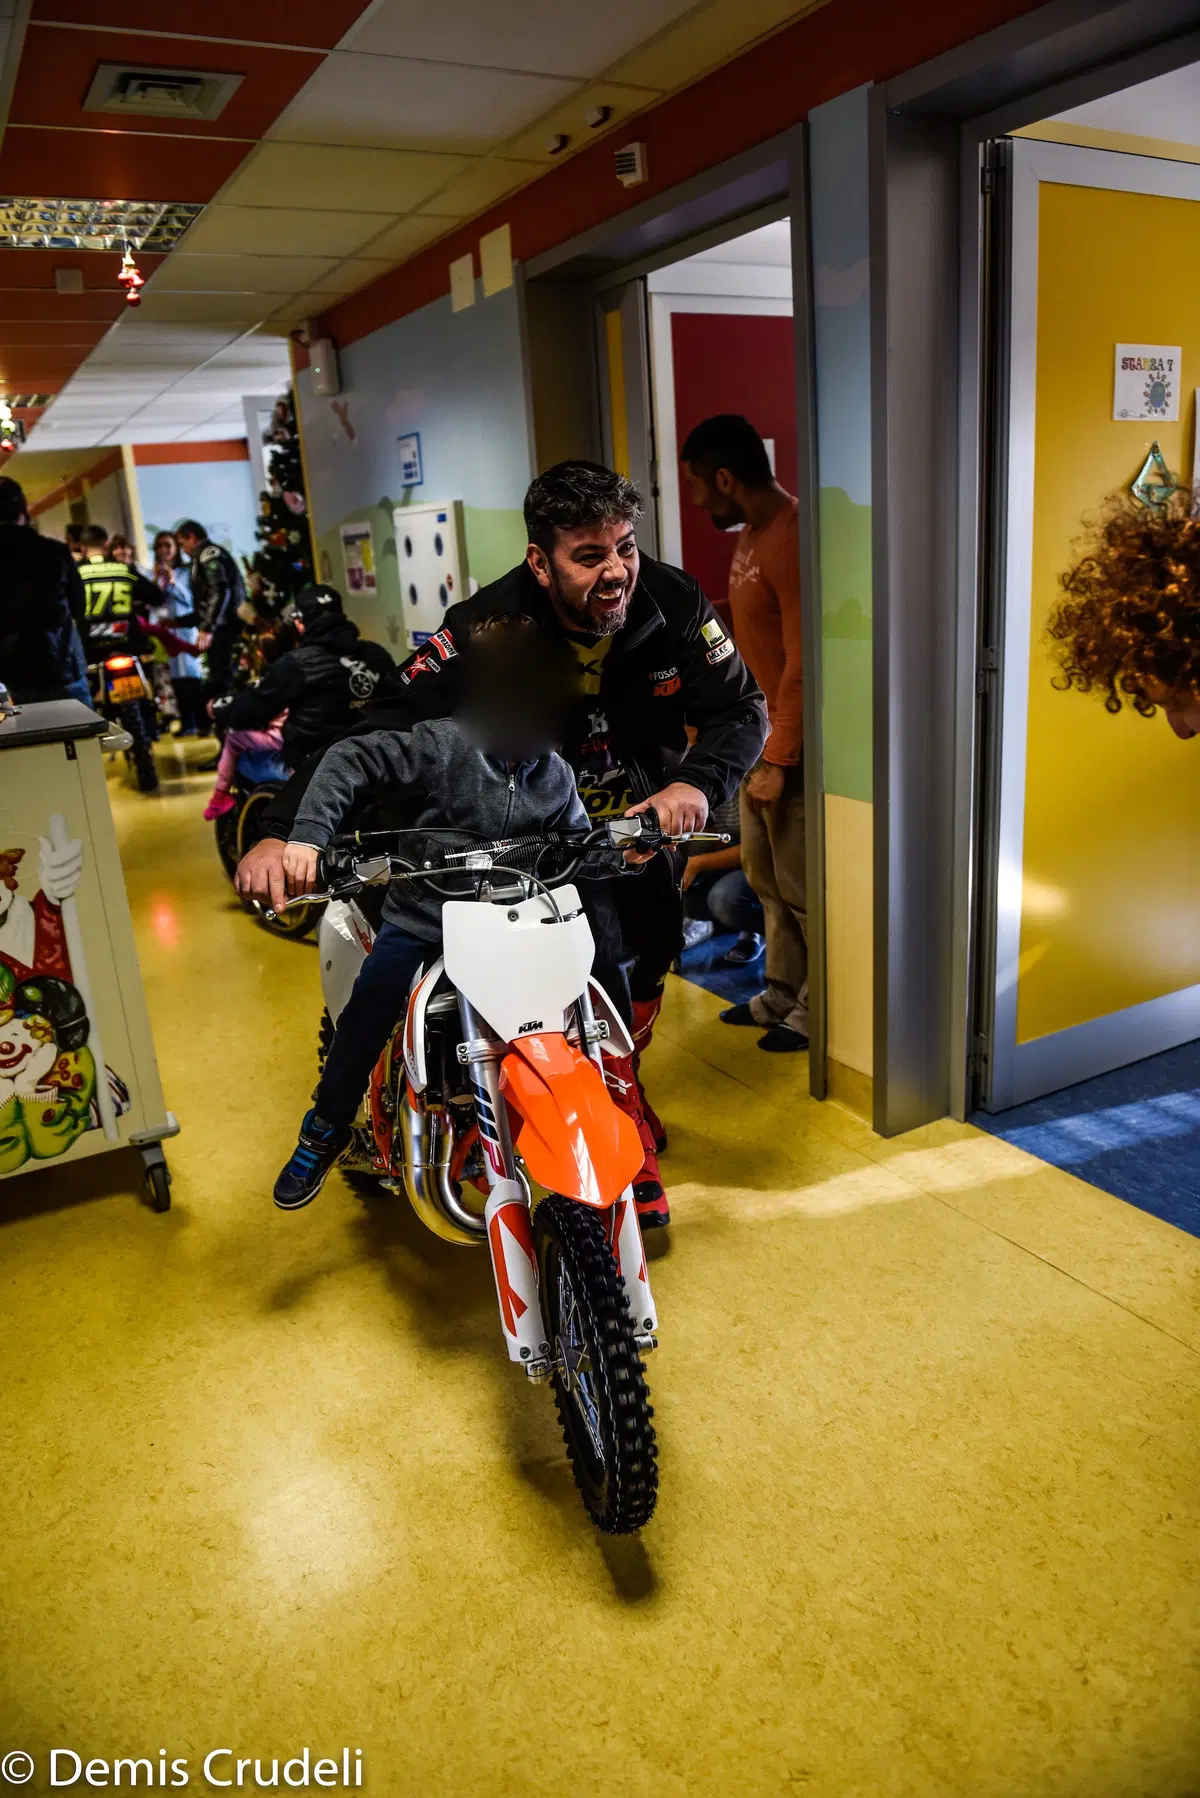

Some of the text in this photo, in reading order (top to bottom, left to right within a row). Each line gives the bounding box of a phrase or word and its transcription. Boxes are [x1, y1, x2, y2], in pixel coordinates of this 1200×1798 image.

[1167, 359, 1174, 372] 7
[437, 632, 456, 656] arexons
[518, 1021, 544, 1034] KTM
